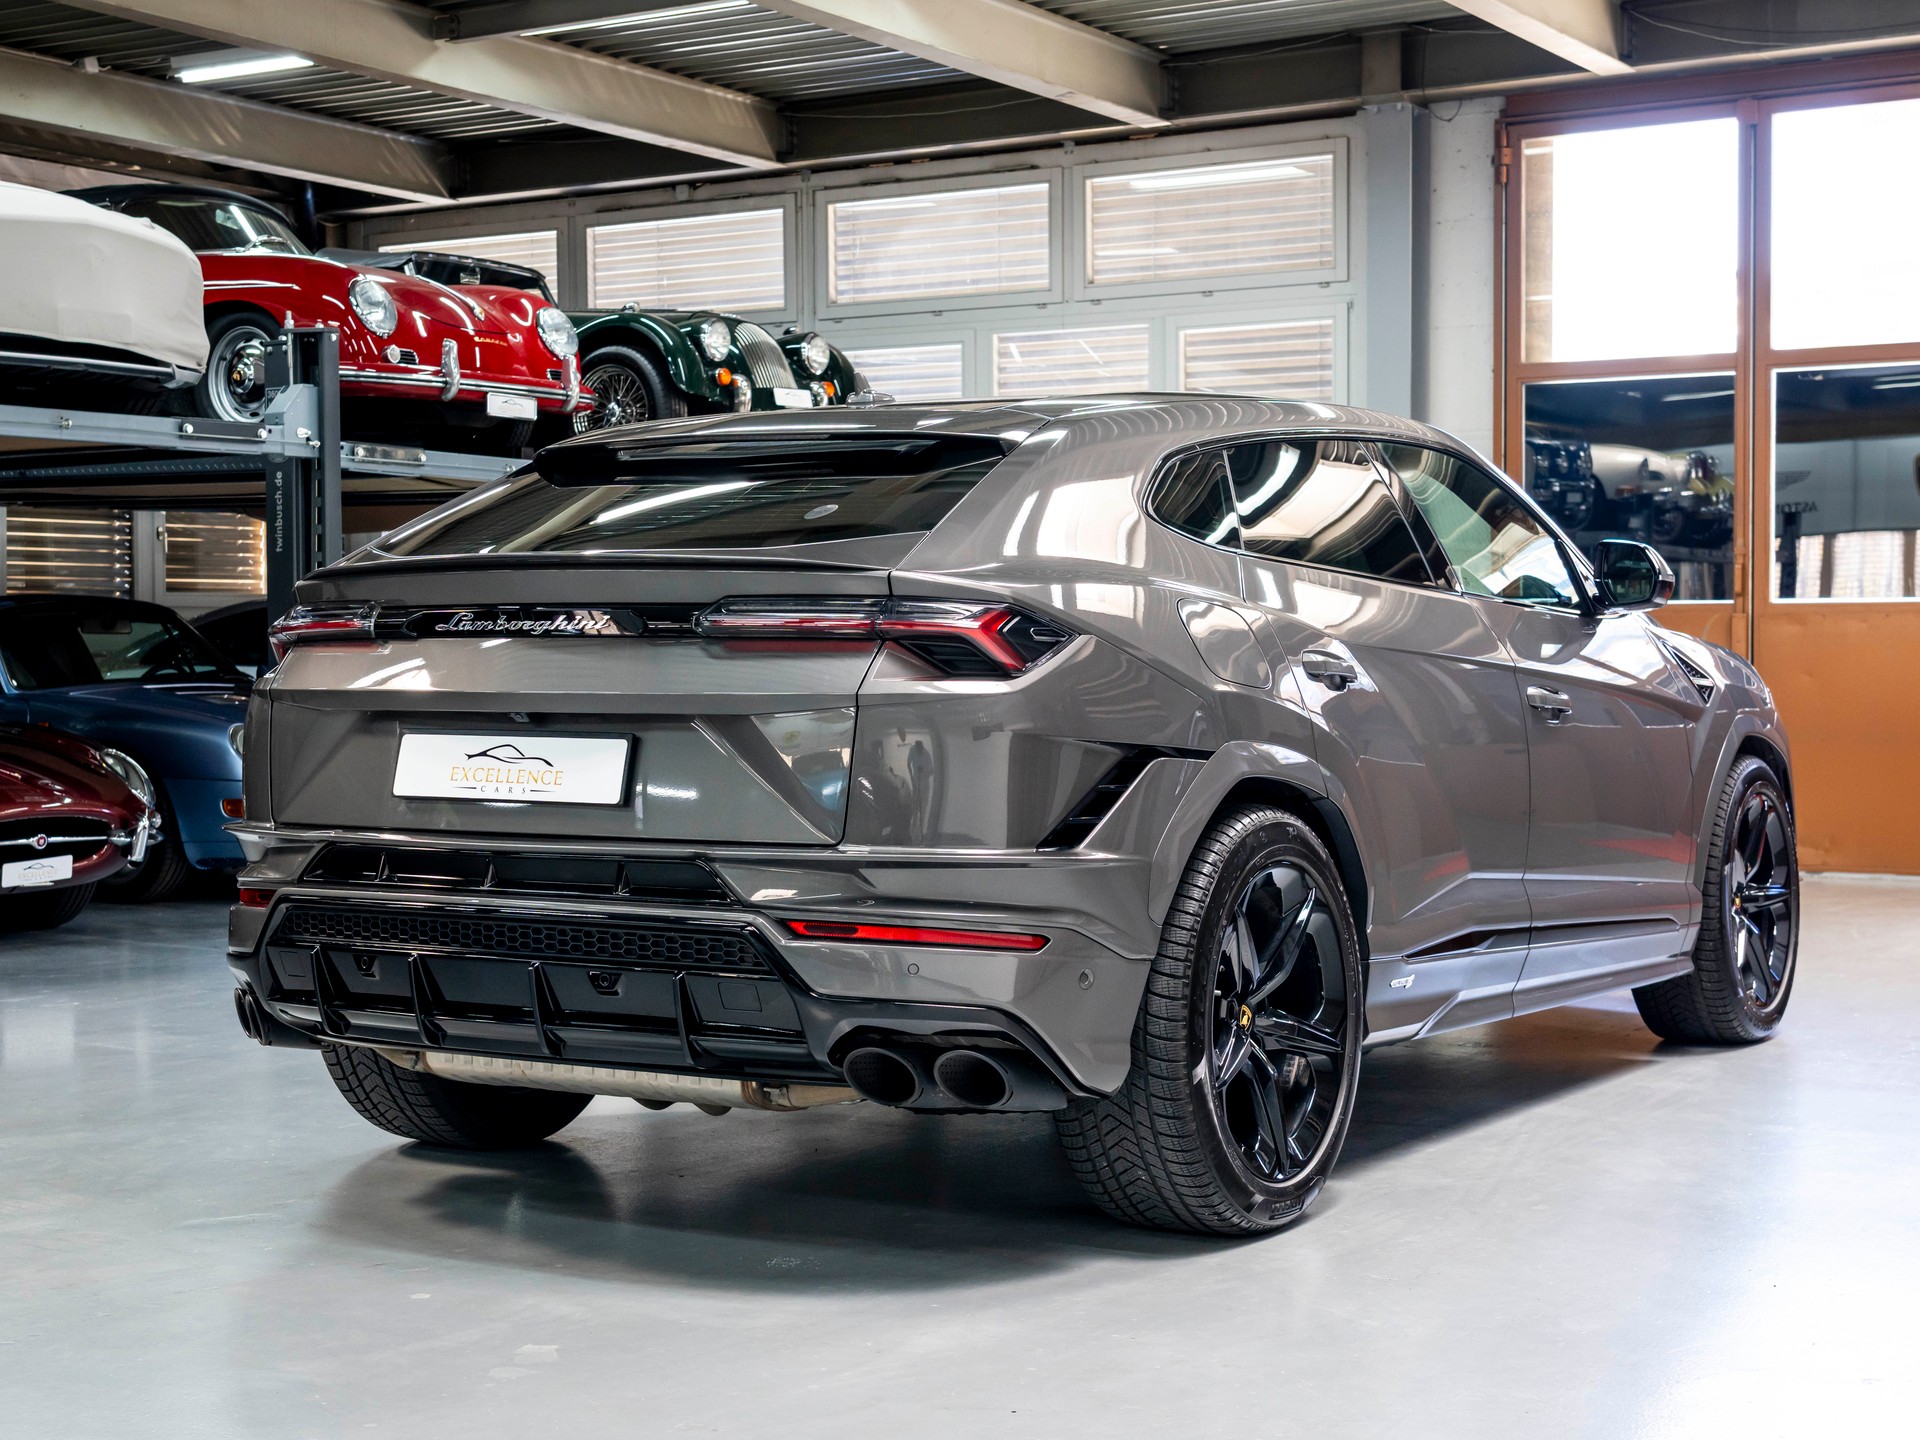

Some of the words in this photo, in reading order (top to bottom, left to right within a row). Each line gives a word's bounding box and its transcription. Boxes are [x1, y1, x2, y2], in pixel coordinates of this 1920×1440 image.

[275, 470, 283, 553] twinbusch.de
[435, 612, 611, 635] Lamborghini
[450, 766, 564, 786] EXCELLENCE
[480, 786, 526, 794] CARS
